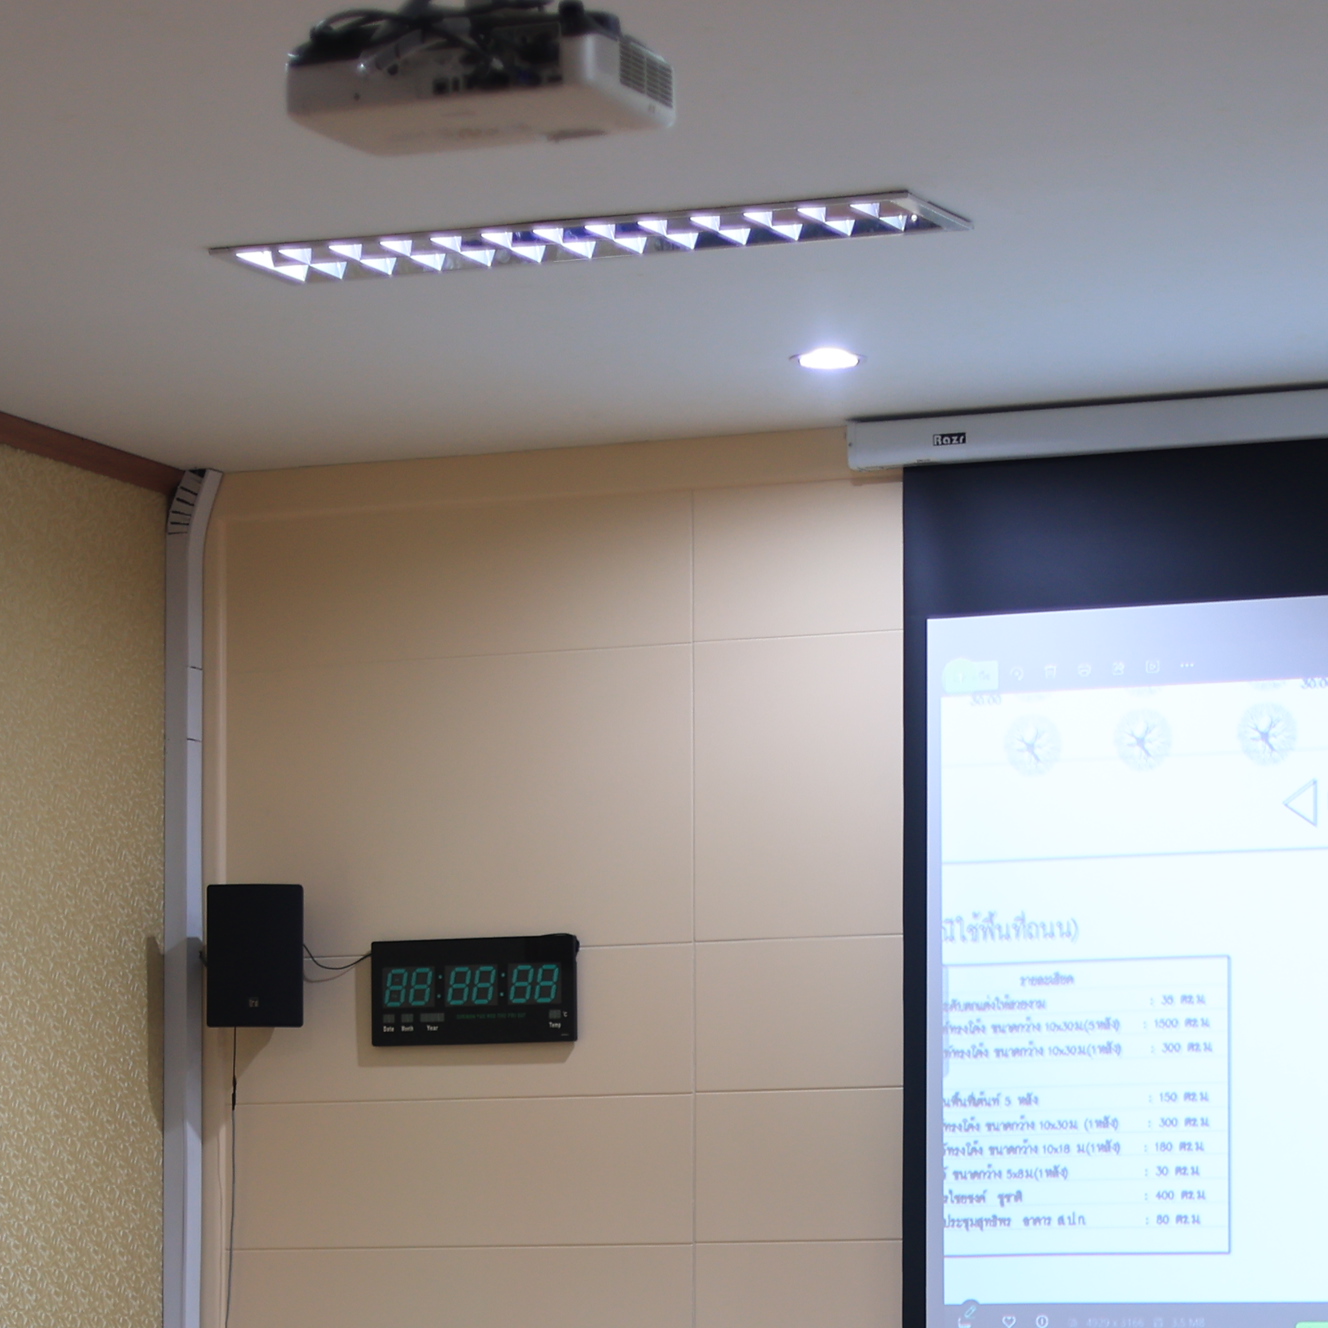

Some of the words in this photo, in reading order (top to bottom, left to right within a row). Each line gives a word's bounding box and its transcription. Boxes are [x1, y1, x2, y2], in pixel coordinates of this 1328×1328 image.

[933, 433, 966, 446] Razr
[1153, 1017, 1180, 1029] 1500
[1161, 1042, 1182, 1053] 300
[1158, 1091, 1178, 1103] 150
[1158, 1116, 1179, 1128] 300
[1154, 1141, 1174, 1153] 180
[1155, 1165, 1169, 1177] 30
[1154, 1189, 1175, 1201] 400
[1155, 1214, 1170, 1226] 80
